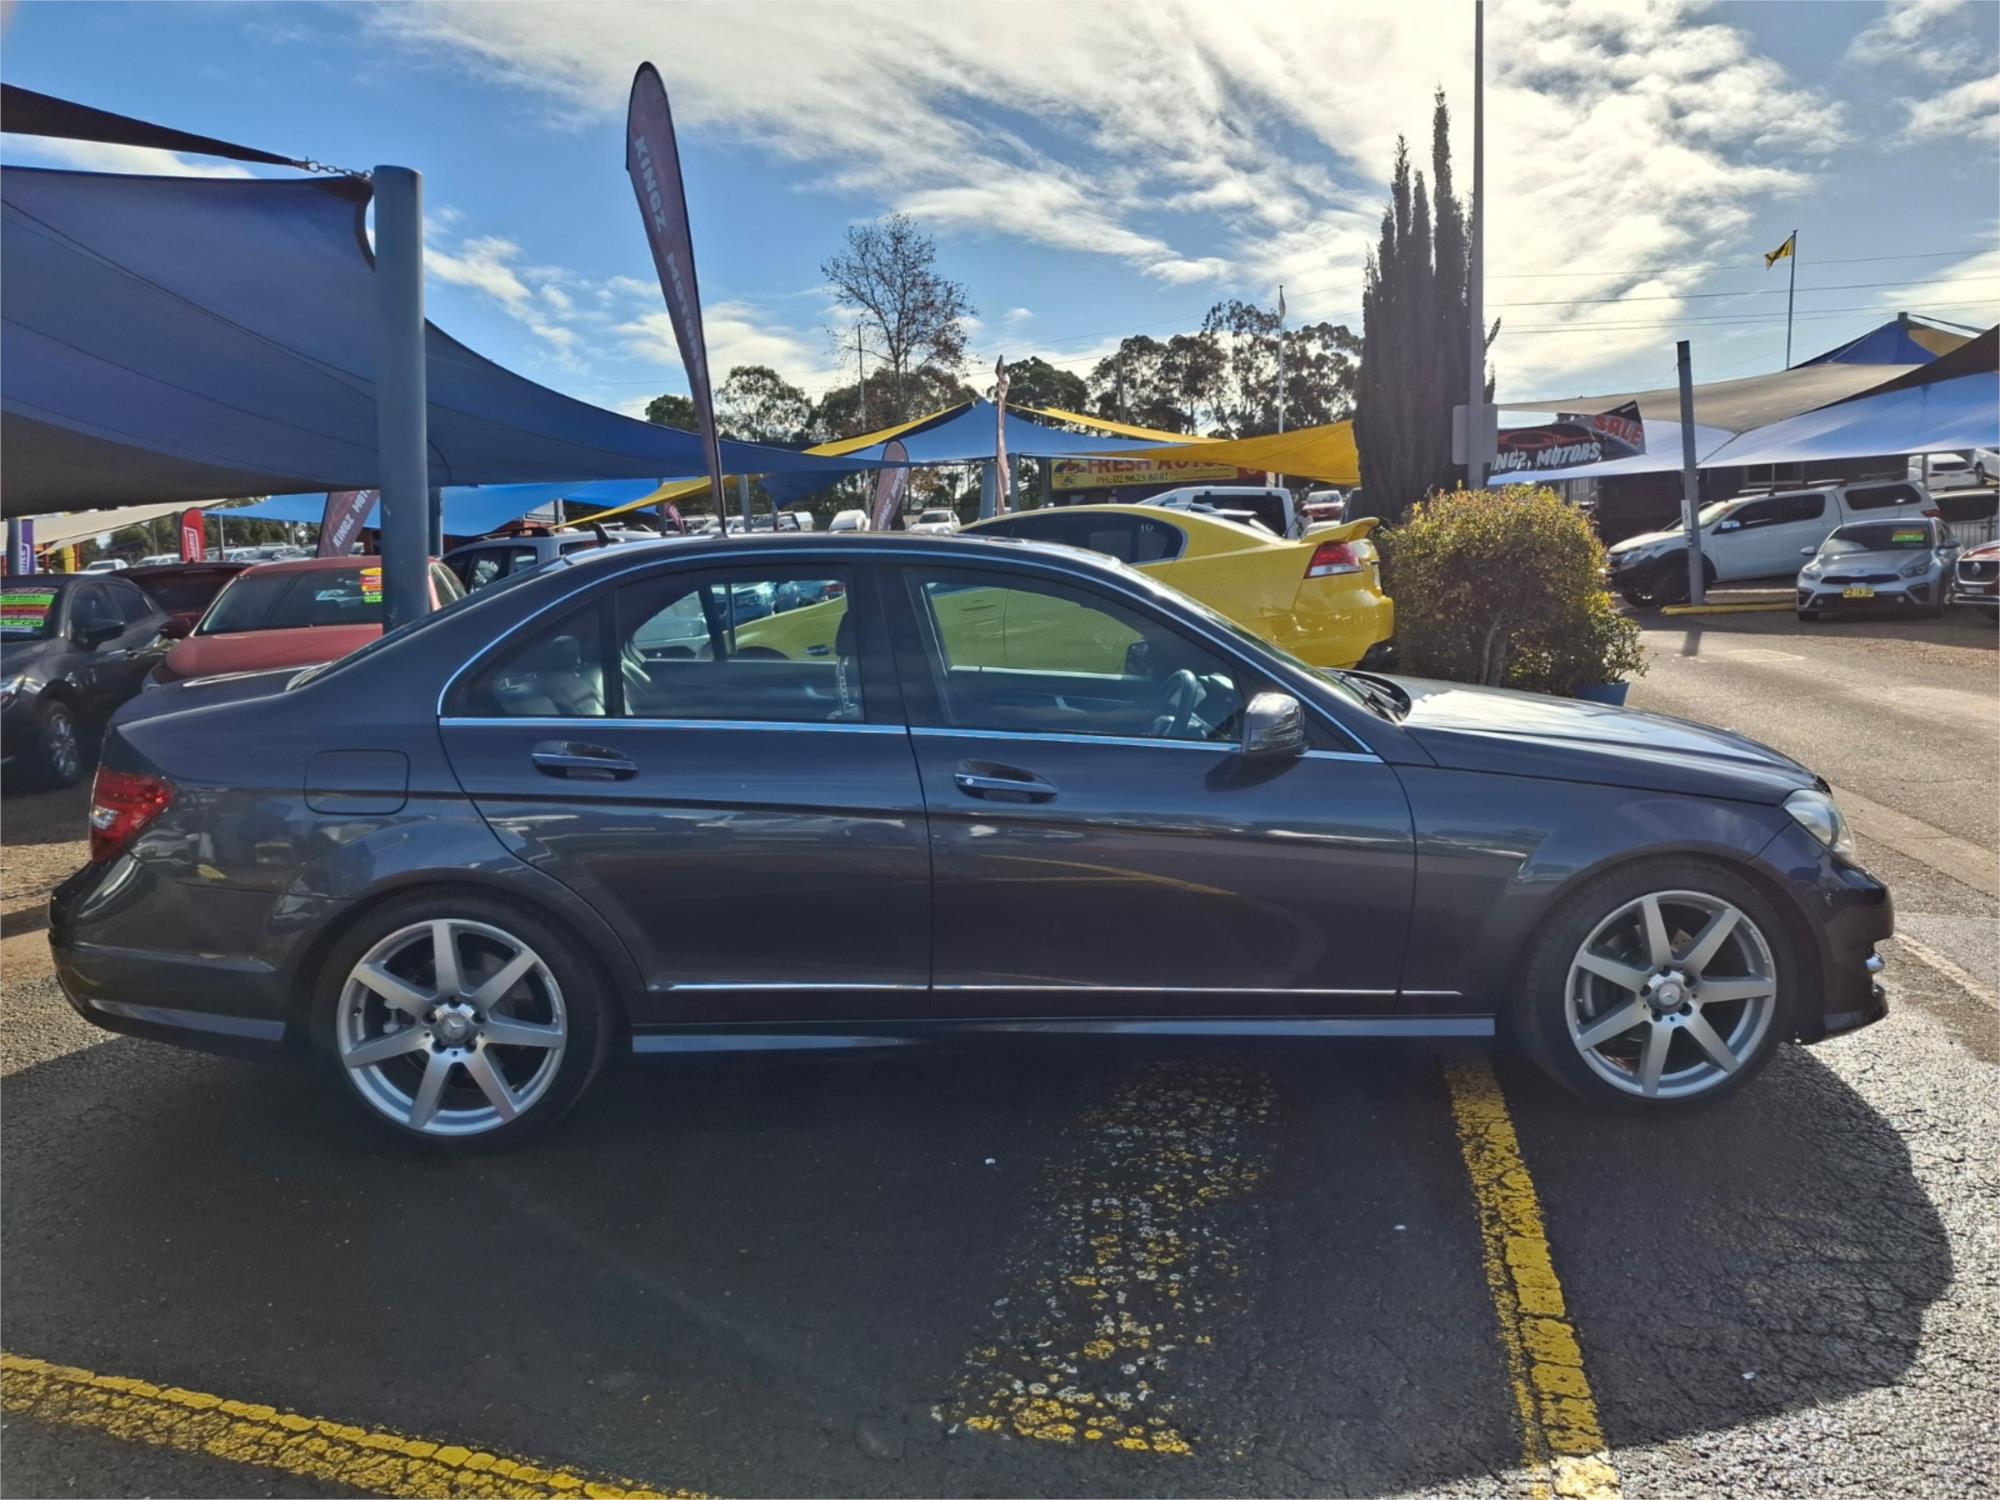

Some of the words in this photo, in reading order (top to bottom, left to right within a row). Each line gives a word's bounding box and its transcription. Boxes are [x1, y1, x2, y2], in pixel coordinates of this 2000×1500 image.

[634, 135, 667, 234] KINGZ
[666, 251, 703, 379] MOTORS
[1594, 414, 1644, 449] SALE
[1087, 460, 1152, 474] FRESH
[1536, 442, 1602, 470] MOTORS
[332, 512, 355, 547] KINGZ
[351, 489, 372, 513] MOT
